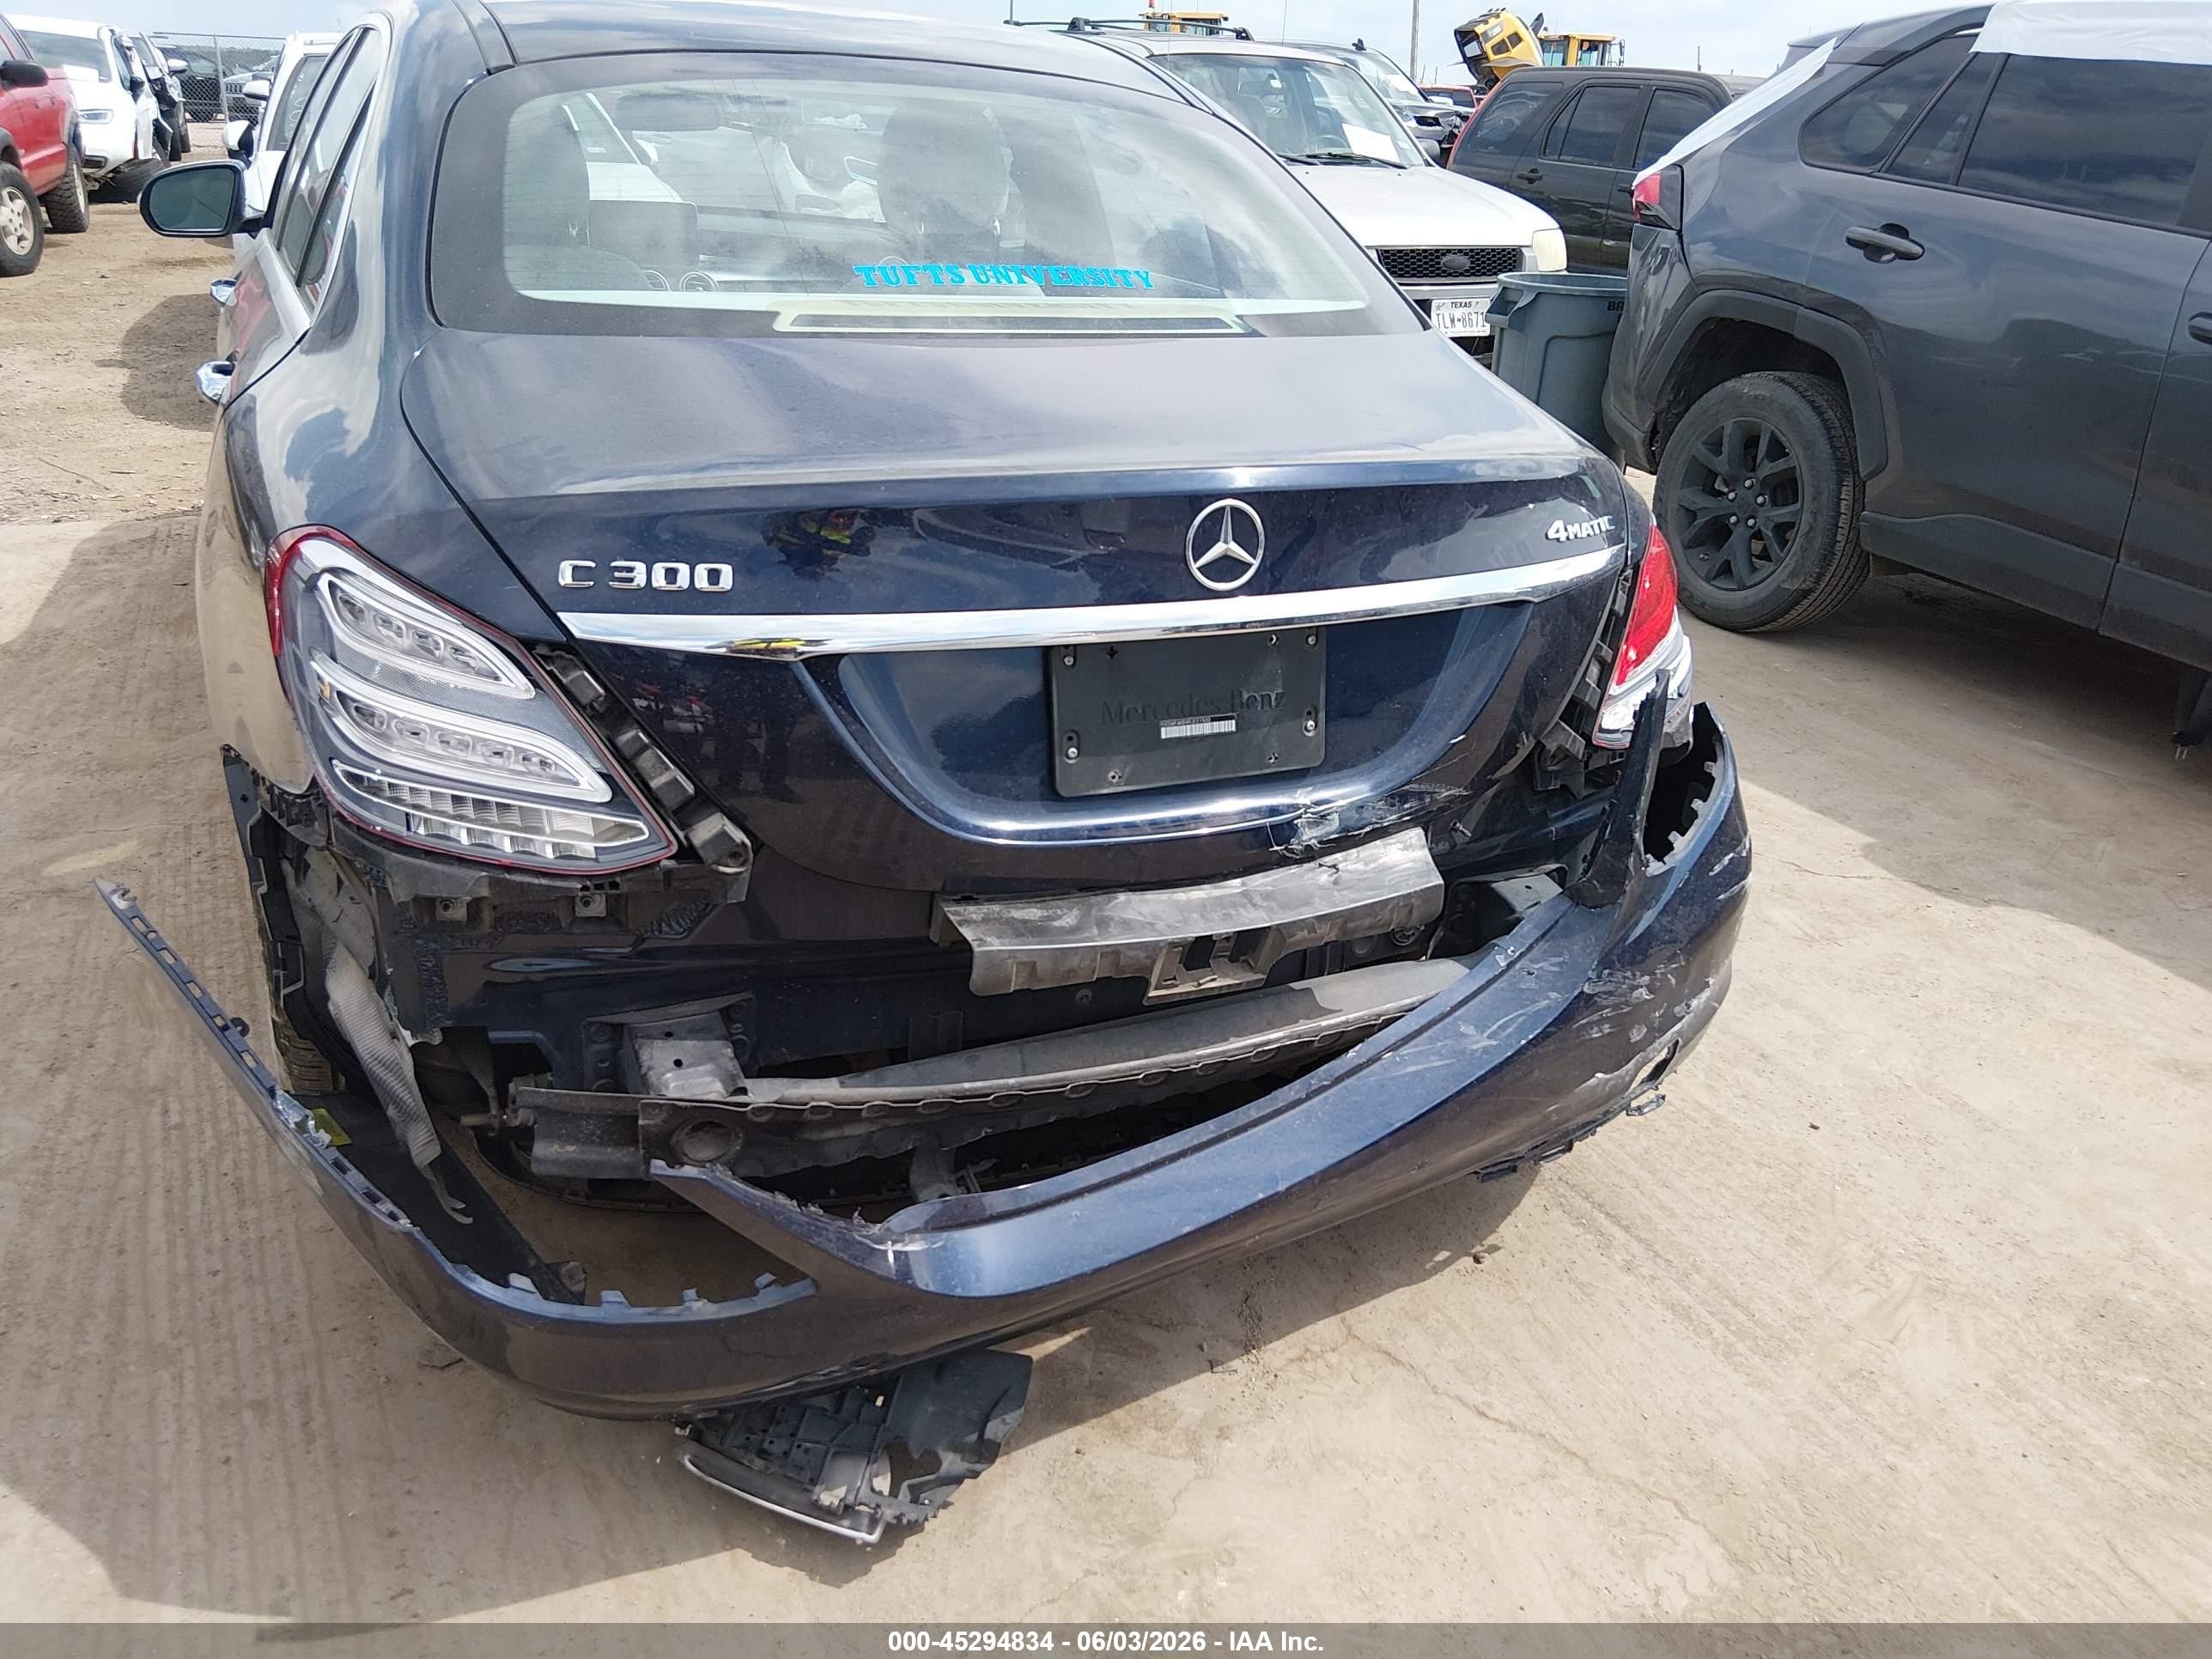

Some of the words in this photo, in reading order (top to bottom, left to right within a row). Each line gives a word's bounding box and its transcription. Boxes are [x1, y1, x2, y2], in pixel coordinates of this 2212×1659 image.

[854, 264, 965, 286] TUFTS
[966, 264, 1154, 289] UNIVERSITY
[1450, 301, 1472, 309] TEXAS
[1547, 515, 1616, 542] 4MATIC
[558, 560, 597, 588] C
[608, 561, 734, 592] 300
